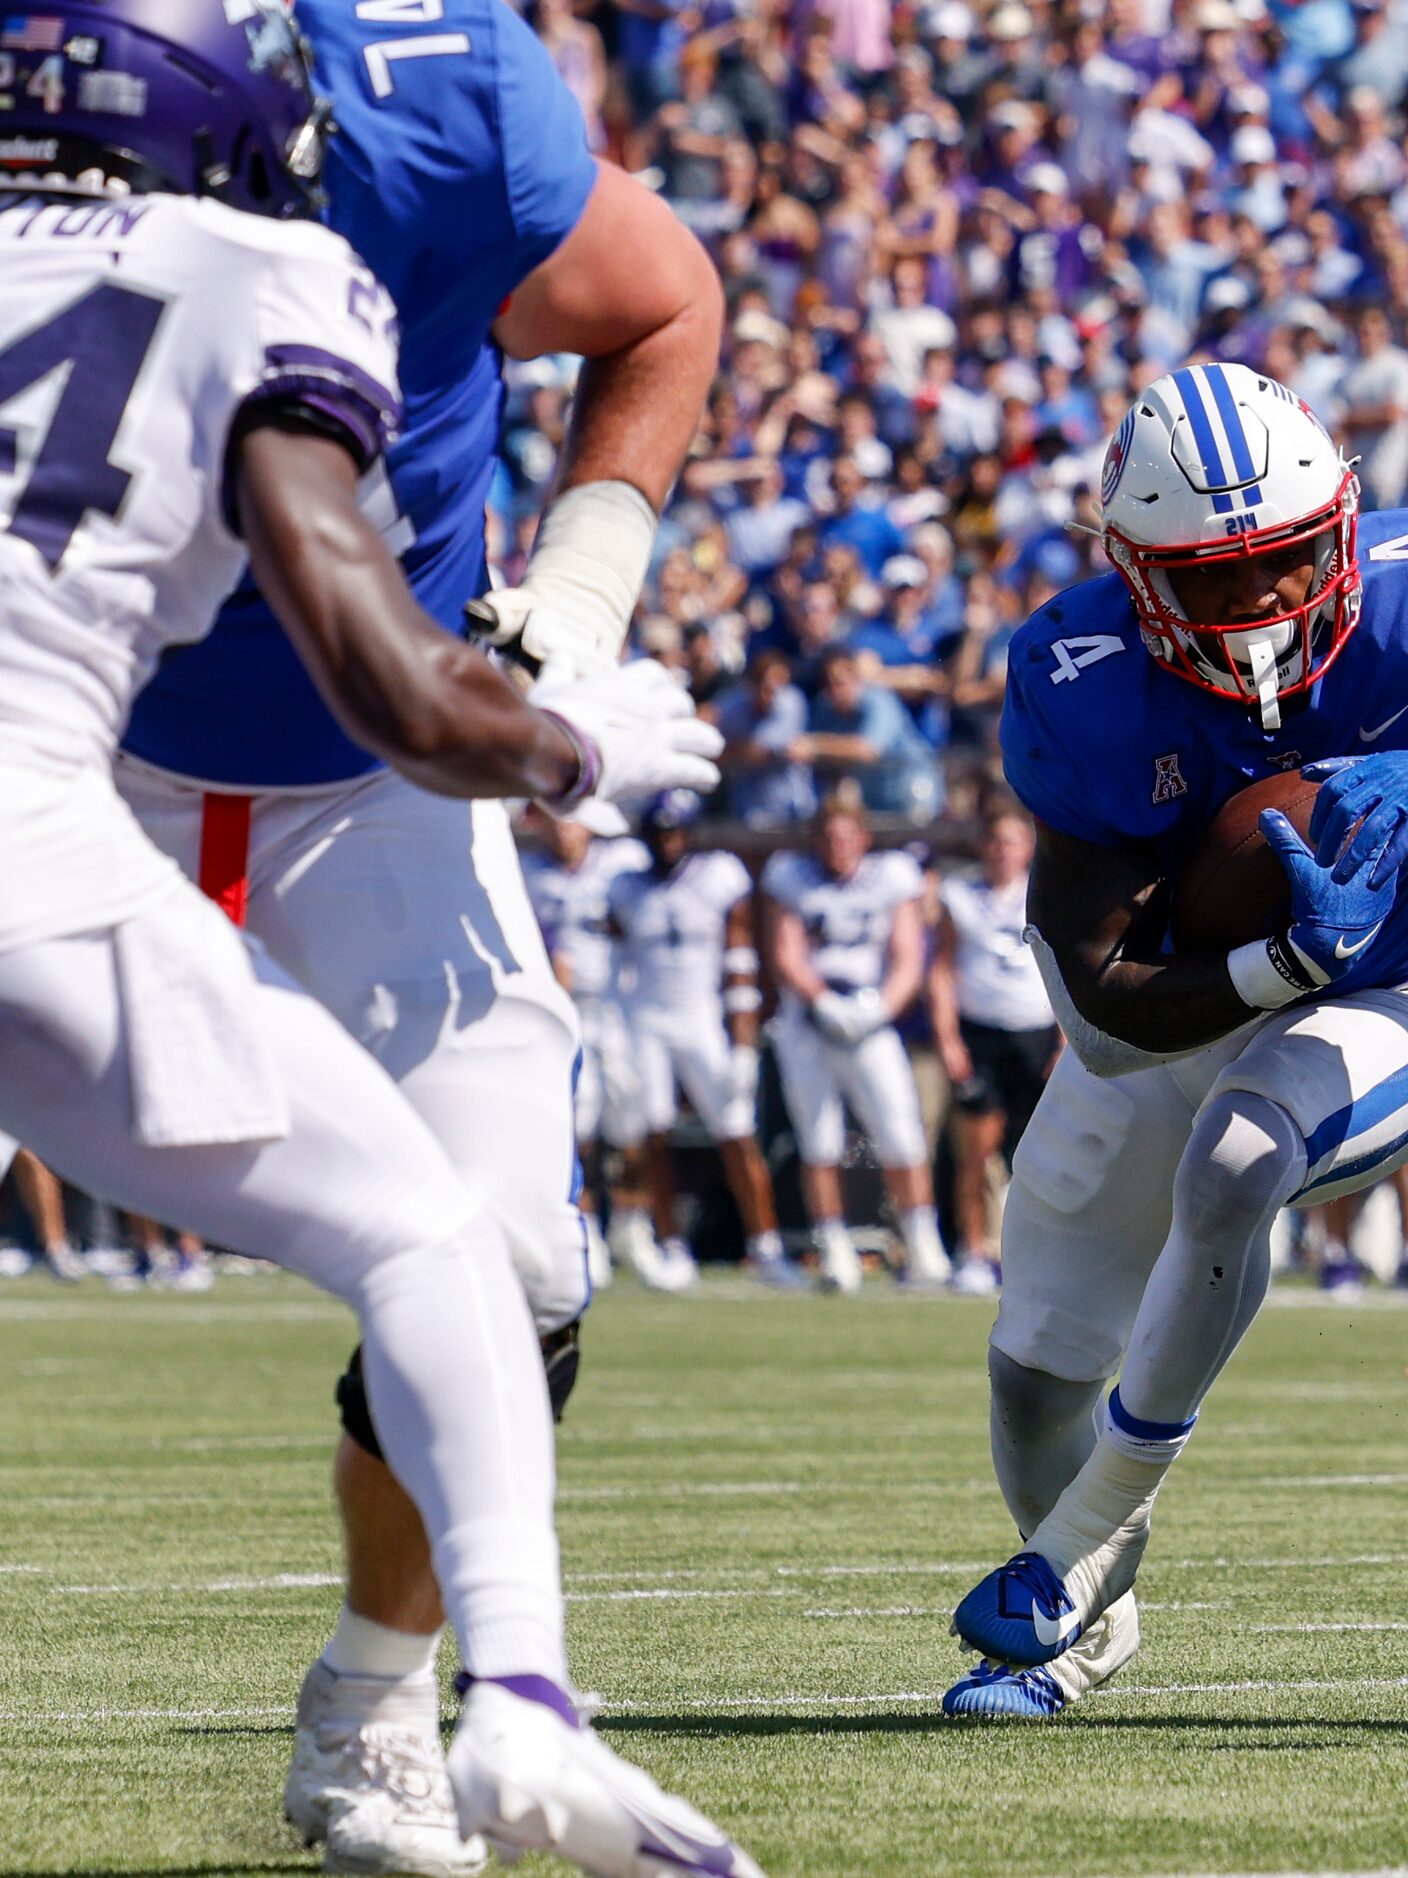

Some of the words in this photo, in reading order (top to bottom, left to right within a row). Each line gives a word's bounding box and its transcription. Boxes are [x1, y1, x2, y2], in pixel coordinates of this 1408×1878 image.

[1225, 512, 1258, 536] 214
[1050, 635, 1126, 684] 4
[1246, 665, 1290, 688] Rell
[1275, 961, 1290, 977] CAN
